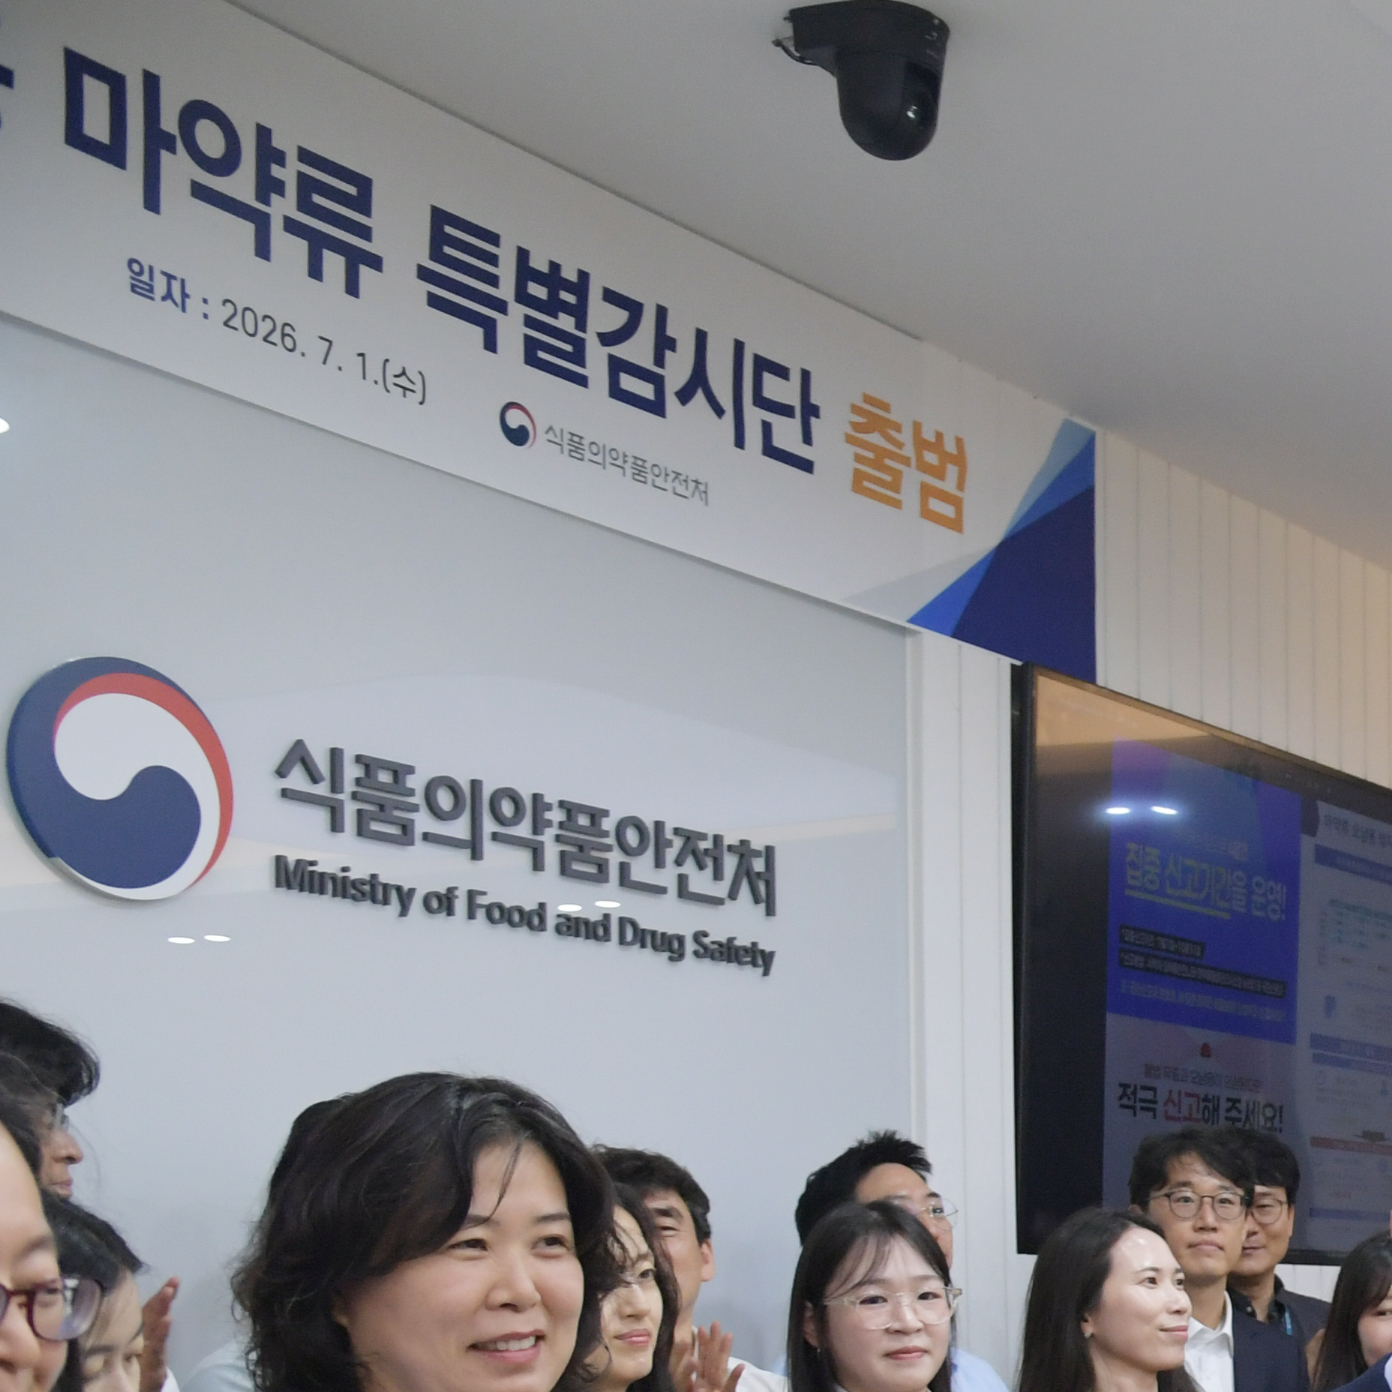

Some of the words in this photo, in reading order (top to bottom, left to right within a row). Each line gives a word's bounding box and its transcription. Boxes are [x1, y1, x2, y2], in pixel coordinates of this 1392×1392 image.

[64, 47, 384, 300] 마약류
[416, 204, 821, 476] 특별감시단
[844, 391, 968, 535] 출범
[126, 257, 191, 314] 일자
[221, 298, 306, 358] 2026.
[318, 335, 344, 373] 7.
[543, 424, 710, 507] 식품의약품안전처
[274, 738, 777, 917] 식품의약품안전처
[274, 854, 417, 918] Ministry
[422, 886, 459, 917] of
[467, 889, 548, 932] Food
[554, 912, 612, 943] and
[618, 915, 686, 962] Drug
[693, 928, 777, 977] Safety
[1117, 1081, 1159, 1120] 적극
[1162, 1088, 1221, 1127] 신고해
[1224, 1096, 1285, 1134] 주세요!
